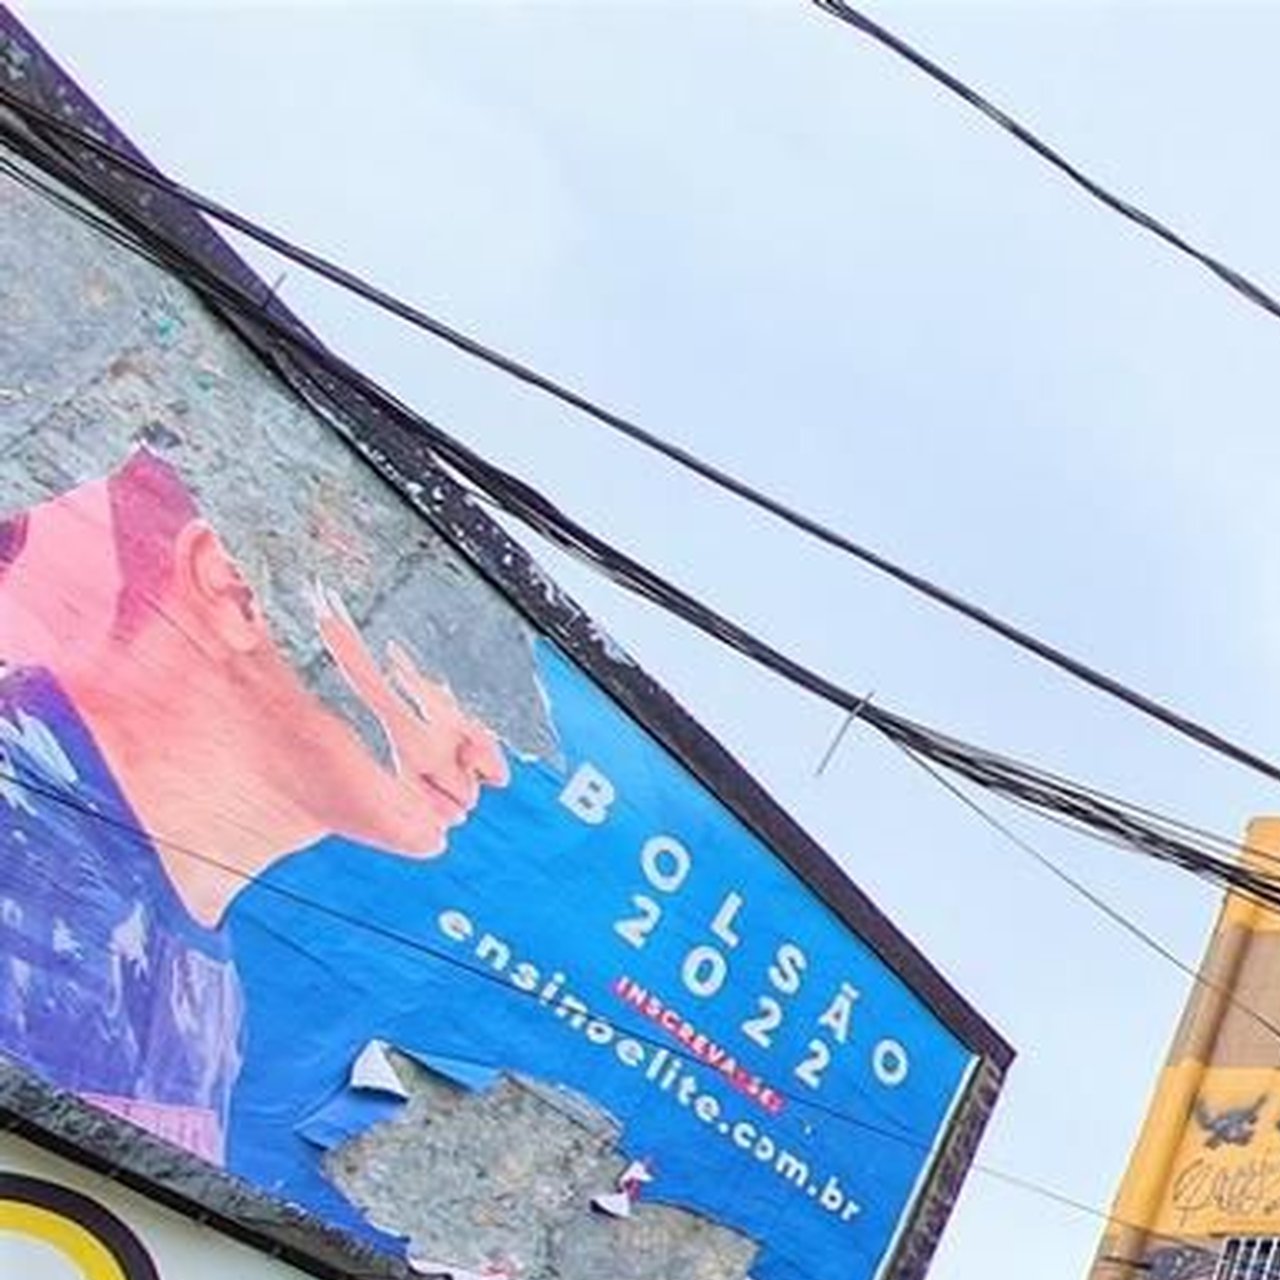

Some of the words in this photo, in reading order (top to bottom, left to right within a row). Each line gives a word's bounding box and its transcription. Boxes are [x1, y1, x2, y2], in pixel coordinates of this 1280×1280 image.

[438, 910, 862, 1223] ensinoelite.com.br
[559, 763, 909, 1086] BOLSÃO
[613, 895, 832, 1089] 2022
